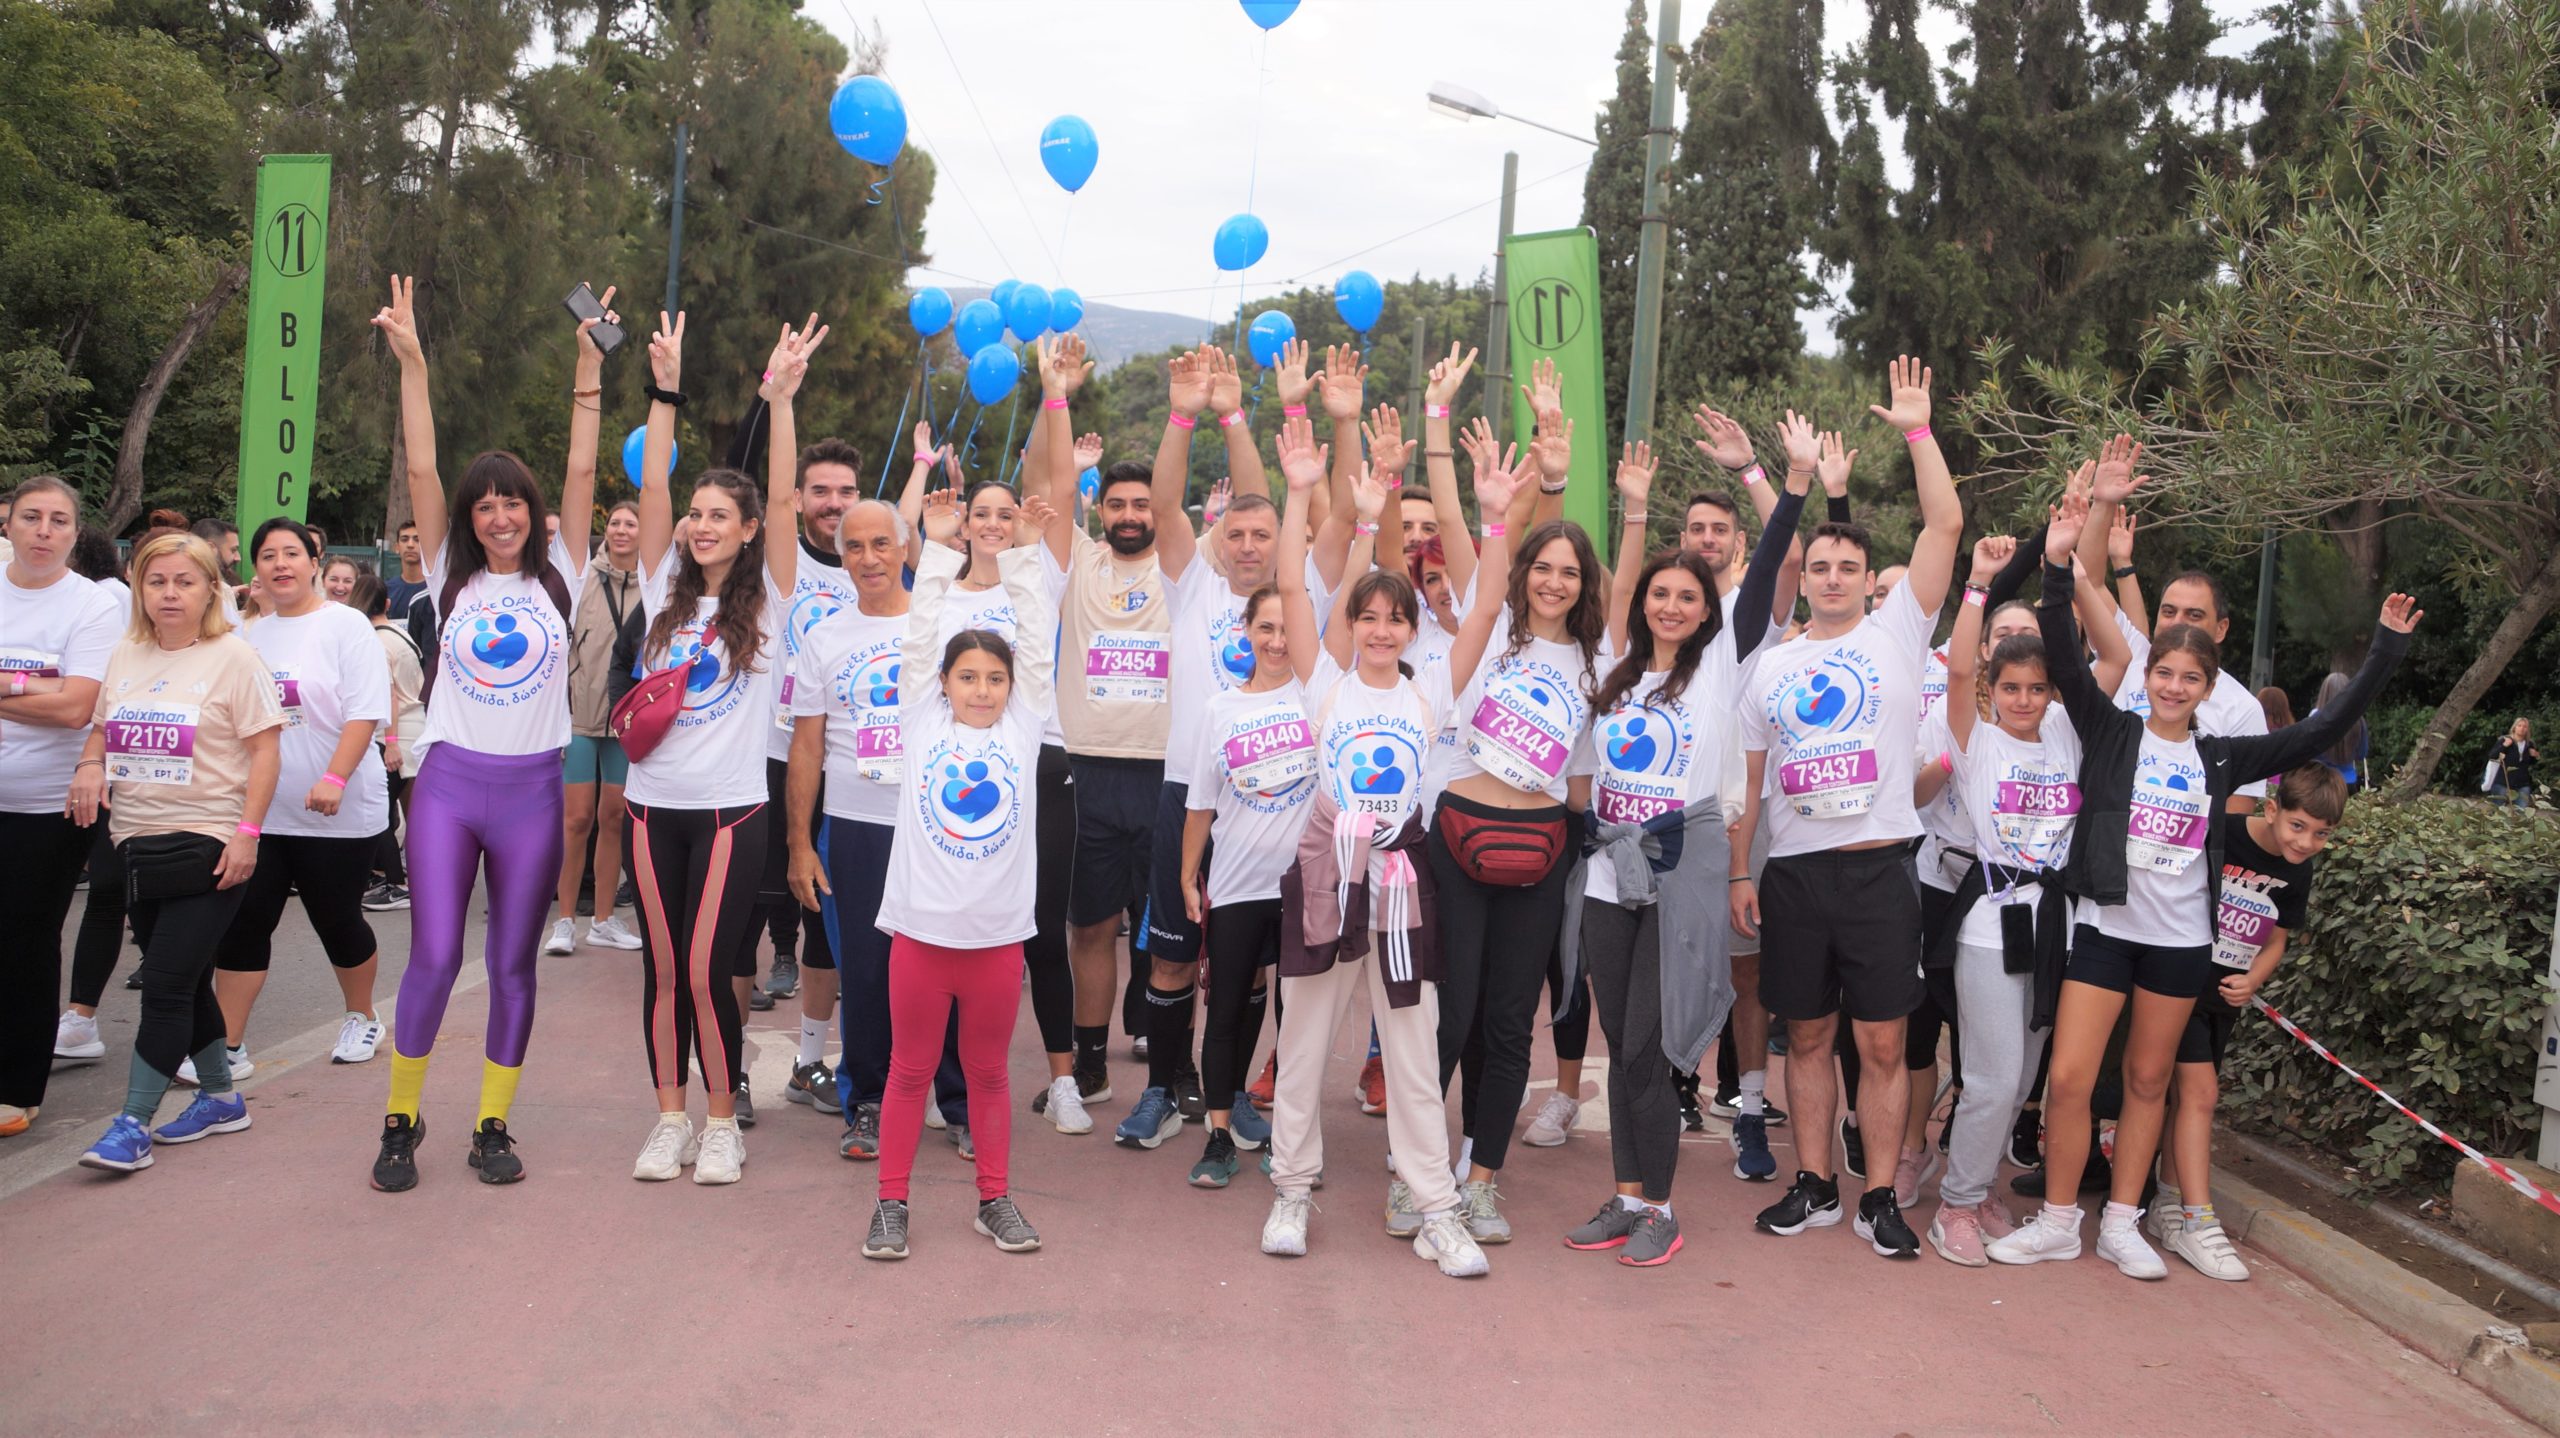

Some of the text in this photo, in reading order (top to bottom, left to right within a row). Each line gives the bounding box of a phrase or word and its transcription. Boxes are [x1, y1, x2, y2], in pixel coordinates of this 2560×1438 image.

[276, 210, 306, 272] 11
[276, 311, 297, 507] BLOC
[1094, 635, 1161, 649] Stoiximan
[1100, 650, 1157, 671] 73454
[113, 705, 187, 723] Stoiximan
[863, 712, 900, 727] Stoix
[1229, 711, 1300, 738] Stoiximan
[1494, 688, 1566, 741] Stoiximan
[119, 724, 180, 749] 72179
[1236, 723, 1304, 759] 73440
[1327, 720, 1354, 750] ρέξε
[1488, 706, 1555, 762] 73444
[1793, 754, 1860, 787] 73437
[1601, 771, 1676, 798] Stoiximan
[2015, 784, 2070, 810] 73463
[1357, 799, 1399, 813] 73433
[2131, 788, 2201, 814] toiximan
[2128, 804, 2193, 839] 73657
[2220, 888, 2271, 916] iximan
[2216, 904, 2261, 938] 3460
